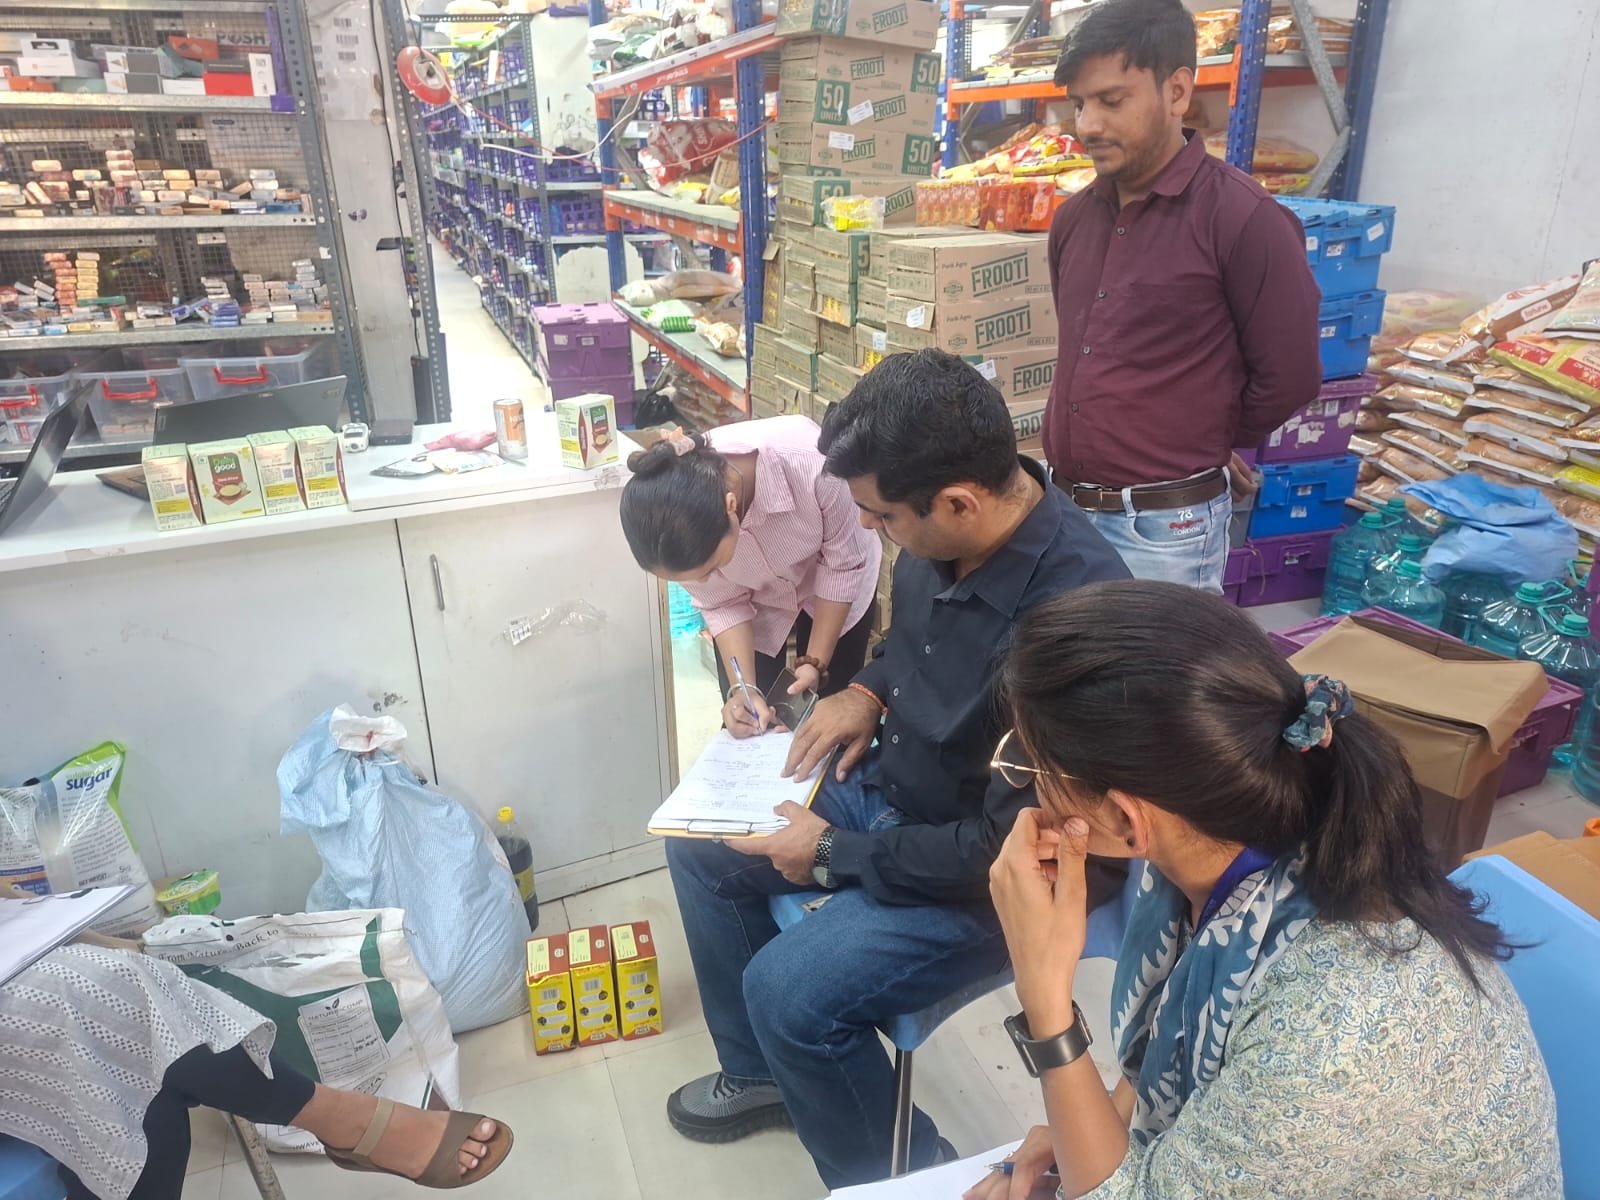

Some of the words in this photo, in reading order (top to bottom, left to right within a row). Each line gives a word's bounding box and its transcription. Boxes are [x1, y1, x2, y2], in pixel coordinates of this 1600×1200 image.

[873, 8, 908, 32] FROOTI
[851, 58, 885, 79] FROOTI
[917, 57, 938, 83] 50
[822, 83, 844, 110] 50
[873, 97, 906, 120] FROOTI
[909, 139, 930, 163] 50
[885, 189, 914, 212] ROOTI
[972, 257, 1028, 292] FROOTI
[975, 310, 1031, 344] FROOTI
[1013, 363, 1056, 392] FROO
[214, 463, 236, 473] good
[66, 768, 112, 791] sugar
[234, 934, 264, 951] Back
[267, 928, 279, 937] to
